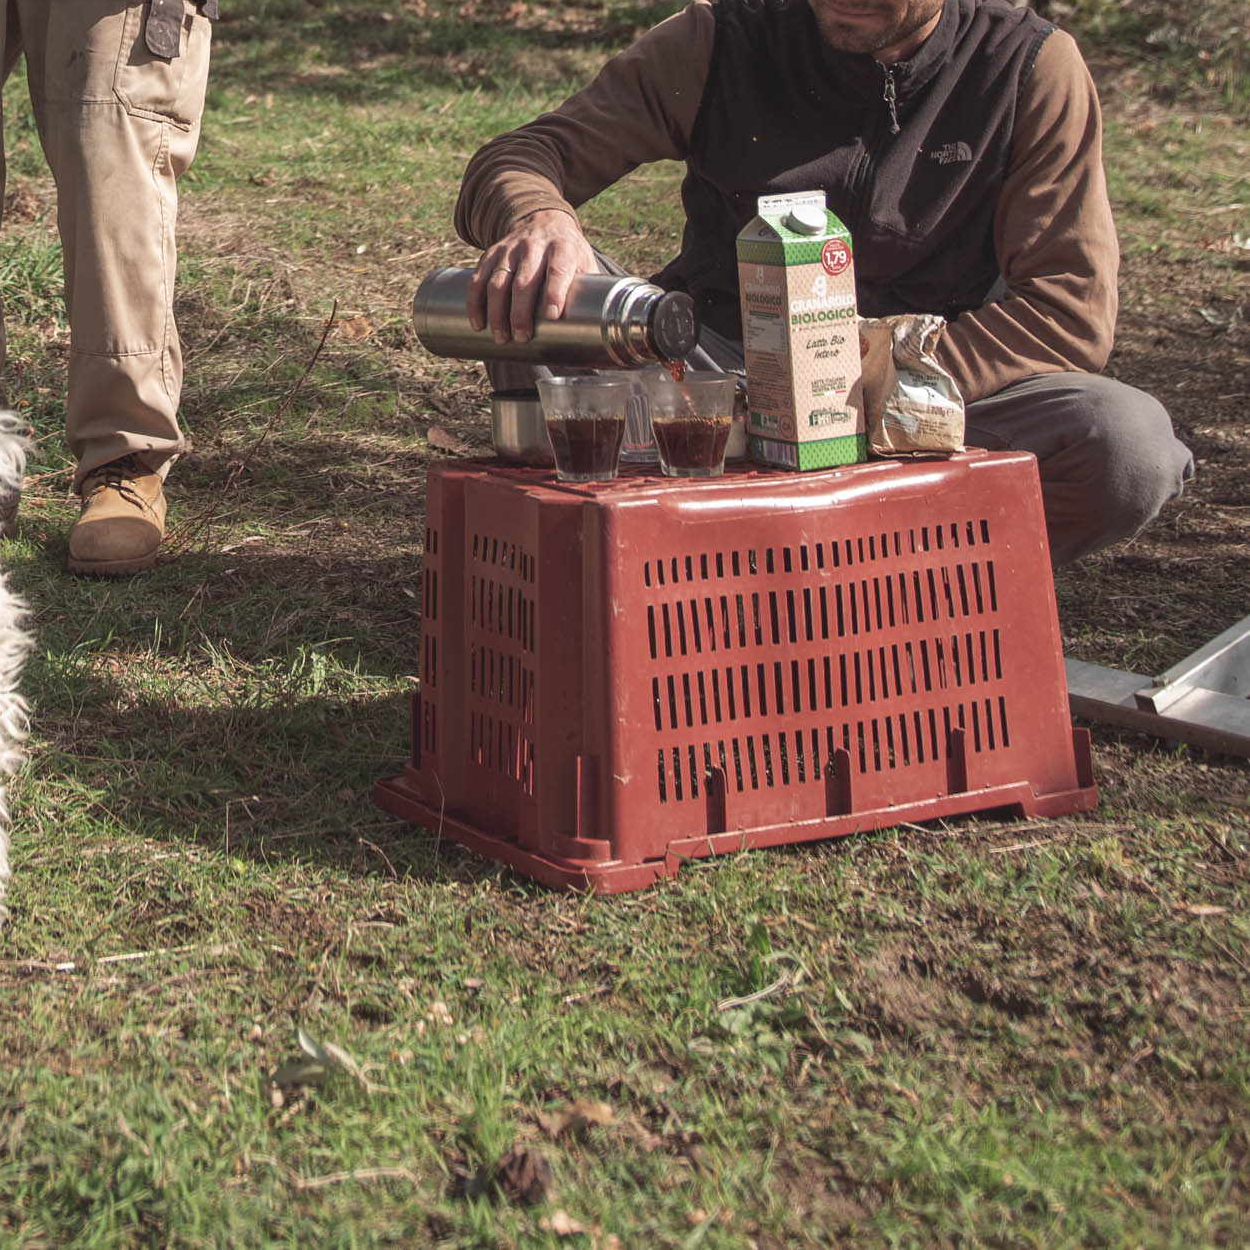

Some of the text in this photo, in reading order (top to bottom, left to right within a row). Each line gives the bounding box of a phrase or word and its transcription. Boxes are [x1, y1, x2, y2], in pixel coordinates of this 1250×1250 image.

[825, 250, 847, 267] 1,79
[746, 293, 782, 305] BIOLOGICO
[790, 295, 855, 312] GRANAROLO
[791, 307, 855, 325] BIOLOGICO
[806, 335, 845, 350] Latte Bio
[814, 350, 839, 360] Intero
